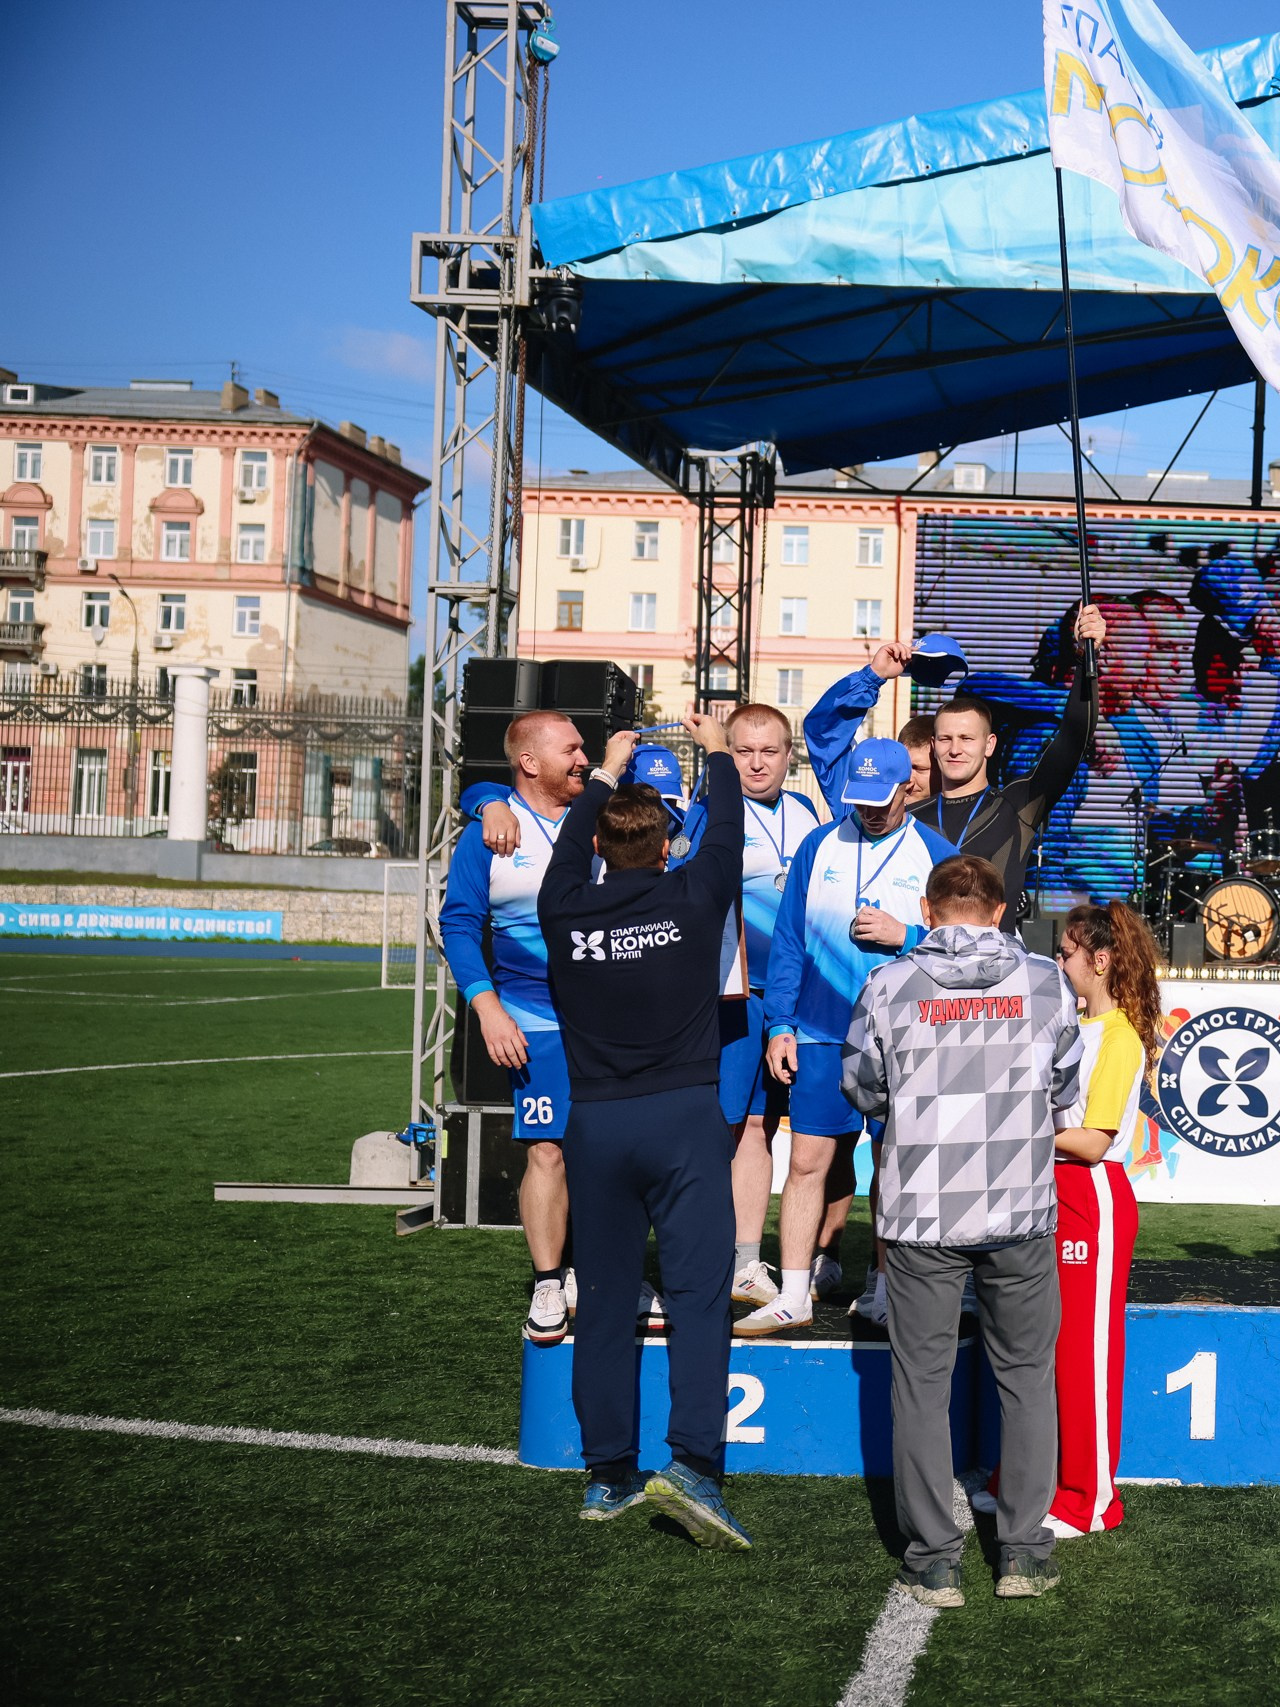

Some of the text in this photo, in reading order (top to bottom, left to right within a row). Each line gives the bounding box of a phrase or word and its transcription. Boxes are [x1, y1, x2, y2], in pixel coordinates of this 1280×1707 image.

[945, 797, 969, 805] CRAFT
[610, 920, 676, 938] СПАРТАКИАДА
[610, 928, 682, 952] КОМОС
[611, 950, 642, 960] ГРУПП
[918, 995, 1023, 1026] УДМУРТИЯ
[1170, 1010, 1238, 1057] КОМОС
[522, 1096, 553, 1125] 26
[1062, 1239, 1088, 1260] 20
[720, 1373, 765, 1444] 2
[1166, 1352, 1217, 1441] 1
